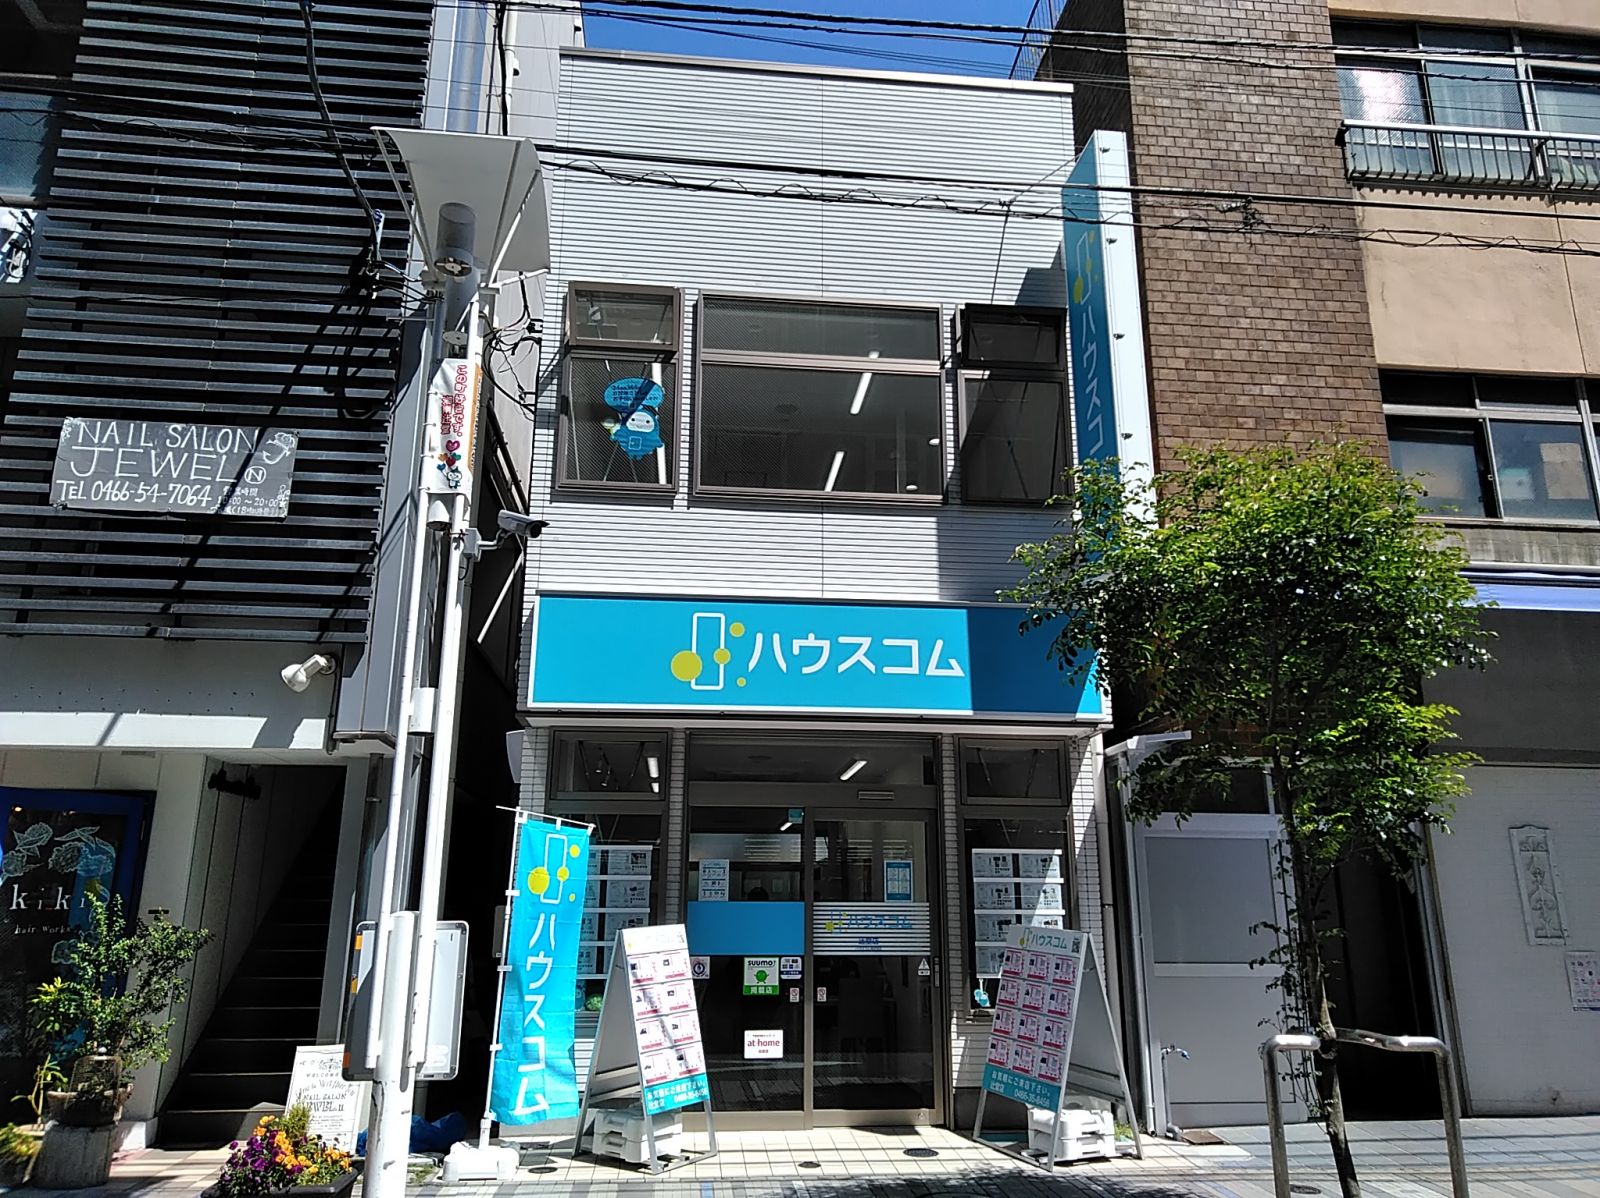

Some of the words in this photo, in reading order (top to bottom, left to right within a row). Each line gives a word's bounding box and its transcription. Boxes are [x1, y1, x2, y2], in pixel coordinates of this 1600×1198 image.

[77, 421, 153, 447] NAIL
[166, 423, 259, 453] SALON
[70, 445, 238, 483] JEWEL
[55, 479, 87, 501] TEL
[91, 481, 213, 507] 0466-54-7064
[748, 632, 966, 678] ハウスコム
[9, 883, 86, 911] kiki
[1031, 933, 1068, 949] ハウスコム
[513, 911, 556, 1117] ハウスコム
[747, 1039, 756, 1047] at
[757, 1038, 780, 1047] home
